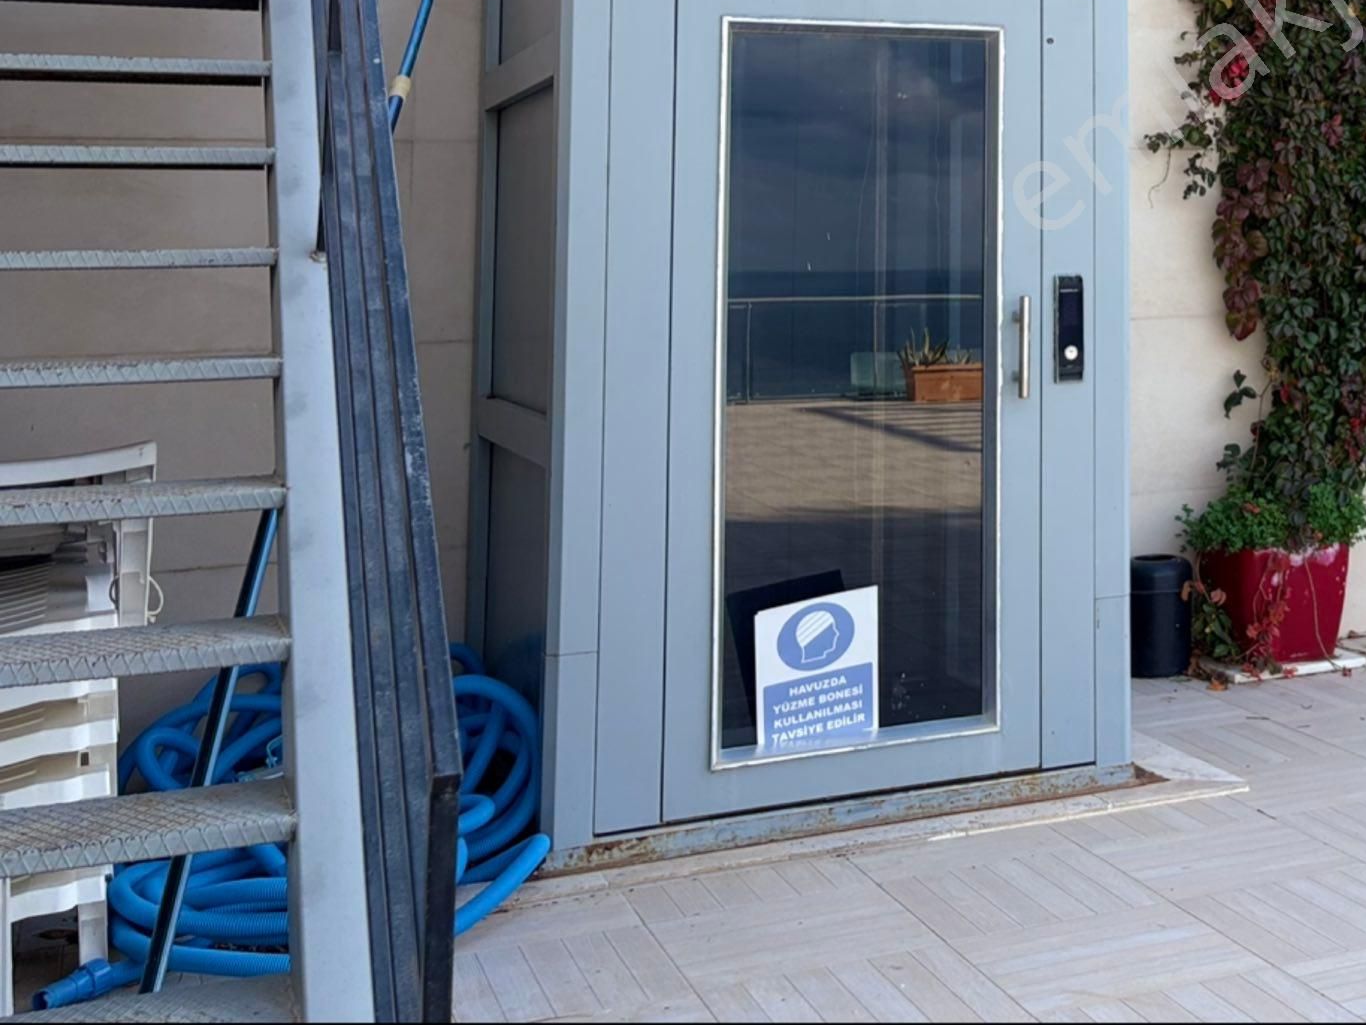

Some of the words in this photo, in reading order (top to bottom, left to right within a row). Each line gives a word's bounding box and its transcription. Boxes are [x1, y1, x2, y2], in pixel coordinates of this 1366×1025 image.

[773, 696, 816, 715] YÜZME
[818, 683, 864, 704] BONESİ
[789, 675, 847, 697] HAVUZDA
[771, 722, 824, 744] TAVSİYE
[826, 712, 865, 731] EDİLİR
[773, 699, 863, 729] KULLANILMASI
